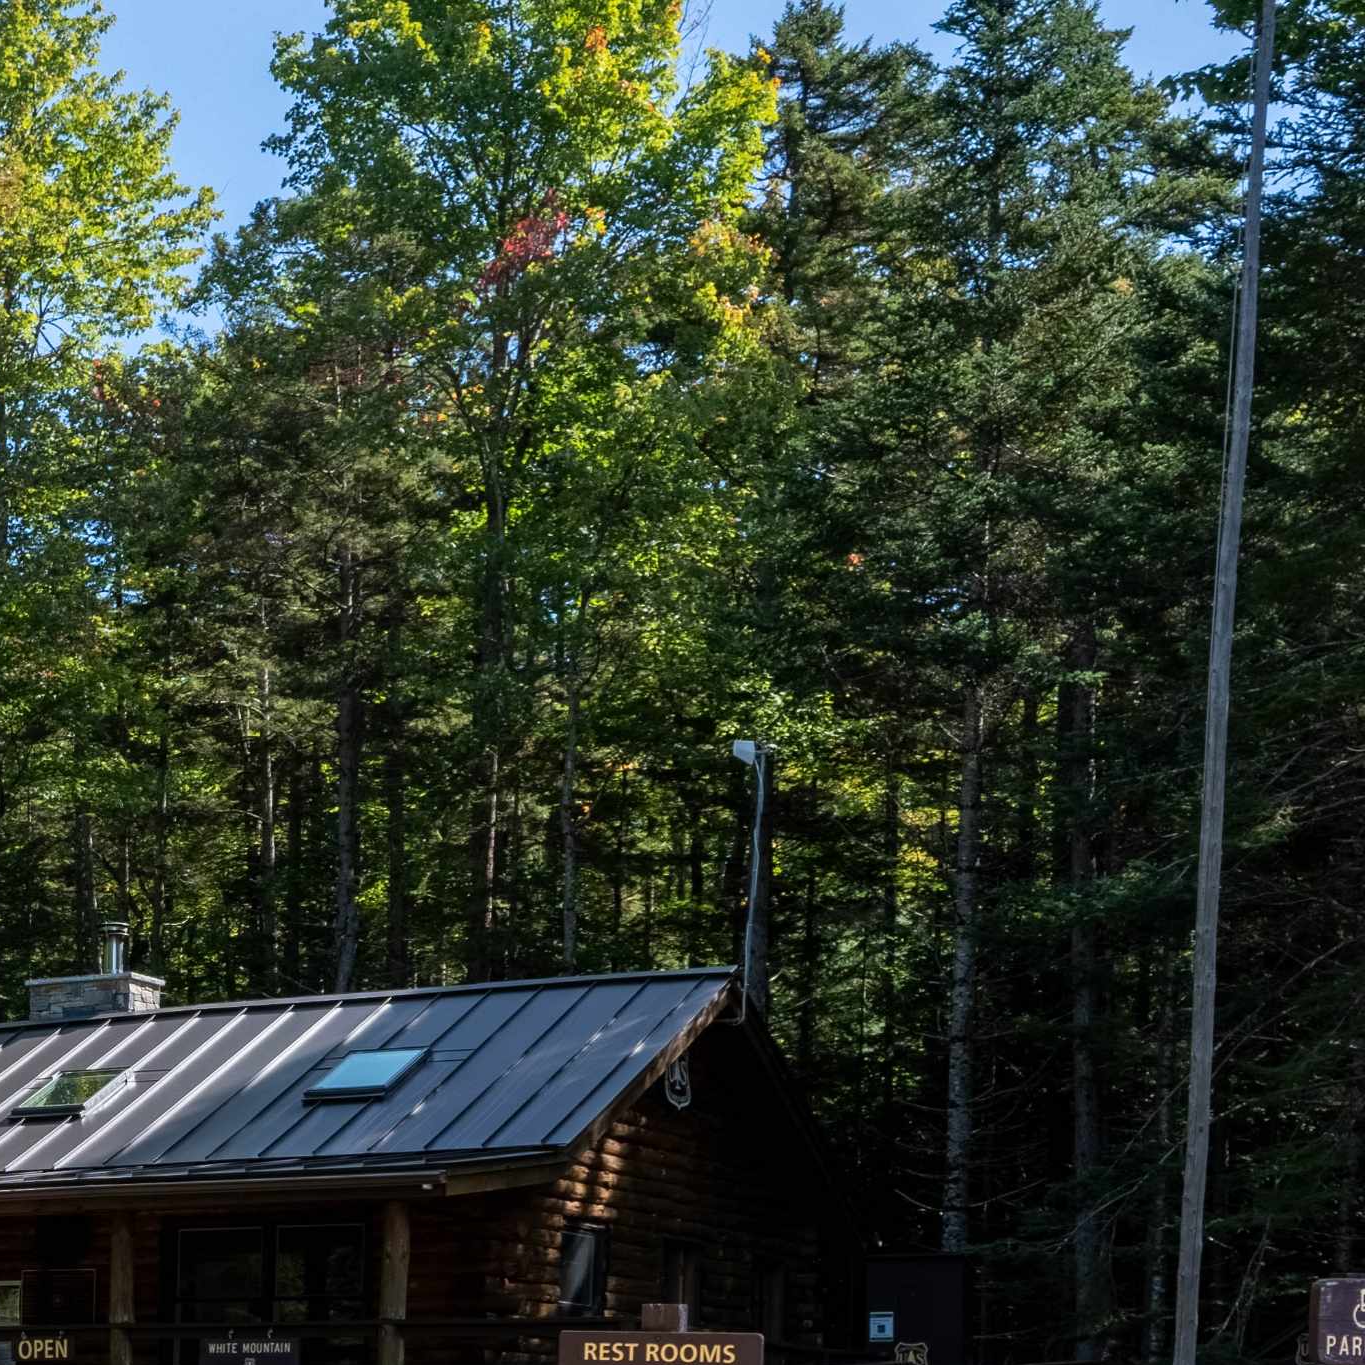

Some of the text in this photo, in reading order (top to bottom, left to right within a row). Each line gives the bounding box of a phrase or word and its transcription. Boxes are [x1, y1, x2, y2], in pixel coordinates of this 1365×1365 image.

[18, 1338, 68, 1360] OPEN
[209, 1342, 291, 1353] WHITE MOUNTAIN
[583, 1342, 735, 1364] REST ROOMS
[1327, 1335, 1365, 1356] PAR
